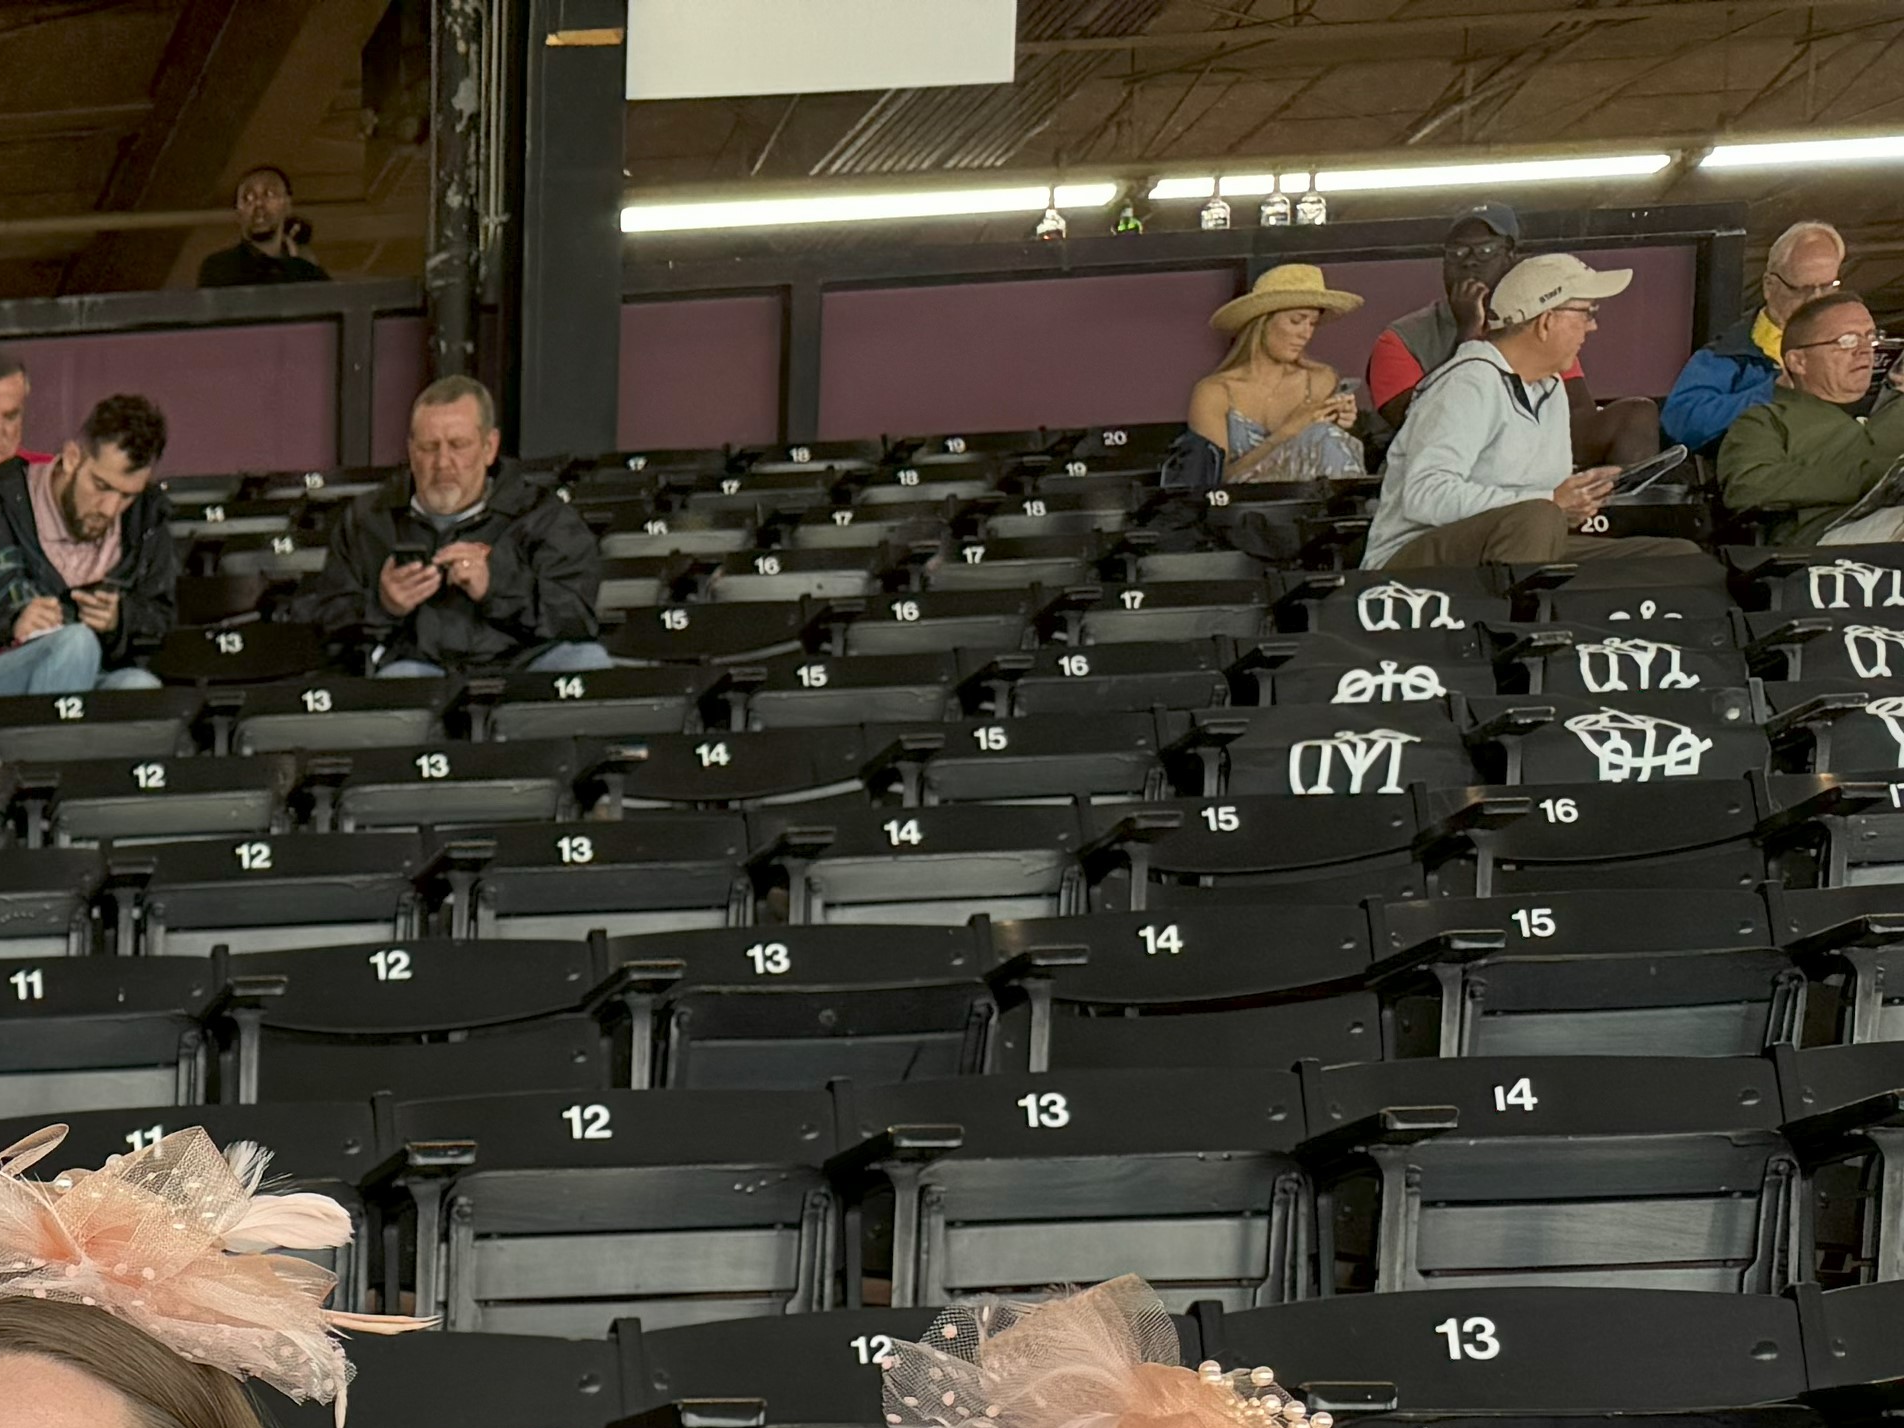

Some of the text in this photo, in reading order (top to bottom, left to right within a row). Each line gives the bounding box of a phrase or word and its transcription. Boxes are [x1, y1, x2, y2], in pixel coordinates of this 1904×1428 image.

[1103, 431, 1127, 446] 20
[791, 447, 810, 463] 18
[897, 470, 919, 486] 18
[1066, 462, 1087, 477] 19
[1023, 500, 1047, 518] 18
[1206, 490, 1229, 506] 19
[832, 511, 853, 527] 17
[1580, 515, 1609, 533] 20
[754, 556, 781, 576] 16
[962, 546, 985, 565] 17
[891, 601, 920, 621] 16
[1120, 590, 1145, 610] 17
[660, 609, 689, 630] 15
[216, 633, 243, 653] 13
[796, 664, 828, 687] 15
[1058, 654, 1090, 677] 16
[301, 689, 332, 712] 13
[554, 677, 585, 699] 14
[54, 697, 83, 719] 12
[973, 726, 1008, 751] 15
[416, 753, 450, 778] 13
[695, 742, 731, 767] 14
[133, 763, 165, 788] 12
[1201, 805, 1240, 832] 15
[1539, 797, 1579, 824] 16
[883, 819, 923, 846] 14
[235, 842, 272, 870] 12
[557, 836, 593, 863] 13
[1511, 907, 1557, 938] 15
[1138, 924, 1184, 955] 14
[369, 949, 413, 981] 12
[746, 942, 791, 974] 13
[9, 969, 43, 1001] 11
[1493, 1077, 1539, 1112] 14
[562, 1104, 613, 1140] 12
[1017, 1092, 1071, 1128] 13
[124, 1124, 165, 1160] 11
[849, 1334, 894, 1366] 12
[1434, 1316, 1501, 1361] 13
